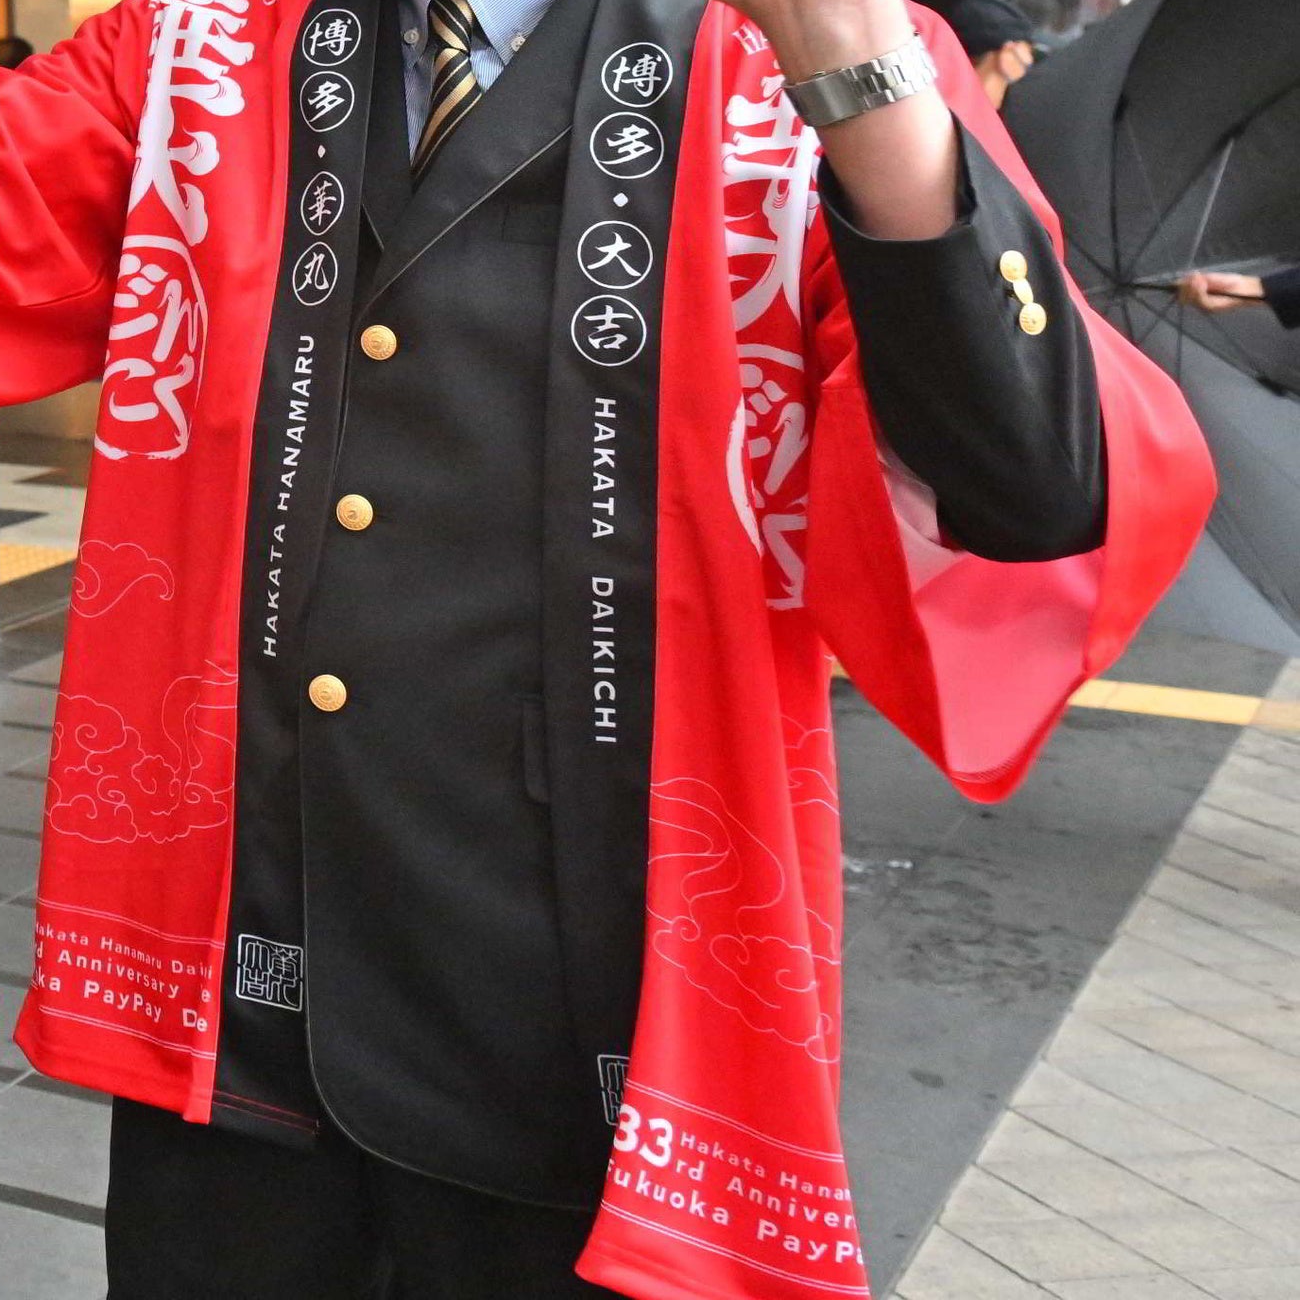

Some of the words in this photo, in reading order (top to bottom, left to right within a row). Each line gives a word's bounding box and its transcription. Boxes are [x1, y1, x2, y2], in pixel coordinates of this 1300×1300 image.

[591, 397, 617, 539] HAKATA
[263, 523, 286, 658] HAKATA
[277, 335, 315, 512] HANAMARU
[591, 575, 618, 744] DAIKICHI
[57, 949, 180, 999] Anniversary
[101, 936, 162, 969] Hanamaru
[83, 979, 162, 1023] PayPay
[680, 1131, 766, 1178] Hakata
